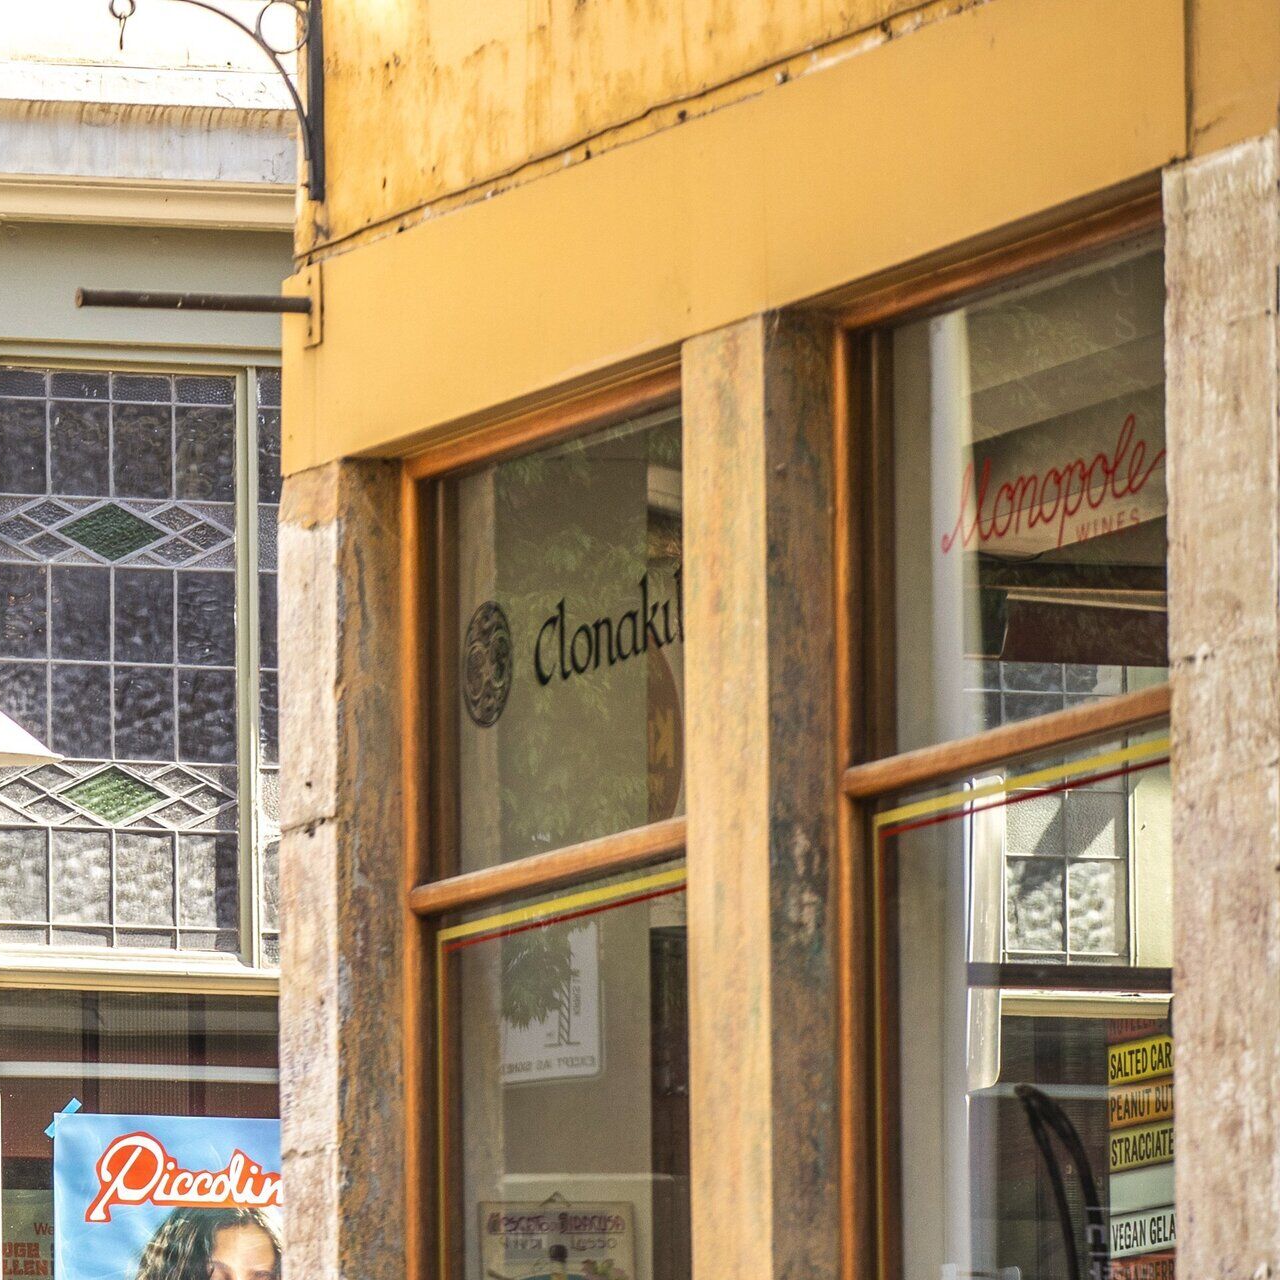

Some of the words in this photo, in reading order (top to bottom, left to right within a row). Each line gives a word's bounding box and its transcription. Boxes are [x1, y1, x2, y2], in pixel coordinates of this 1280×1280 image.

[942, 413, 1166, 553] Monopole
[1075, 507, 1140, 541] WINES
[1110, 1048, 1147, 1080] SALTED
[1110, 1087, 1152, 1122] PEANUT
[1111, 1127, 1175, 1167] STRACCIATE
[1111, 1219, 1146, 1251] VEGAN
